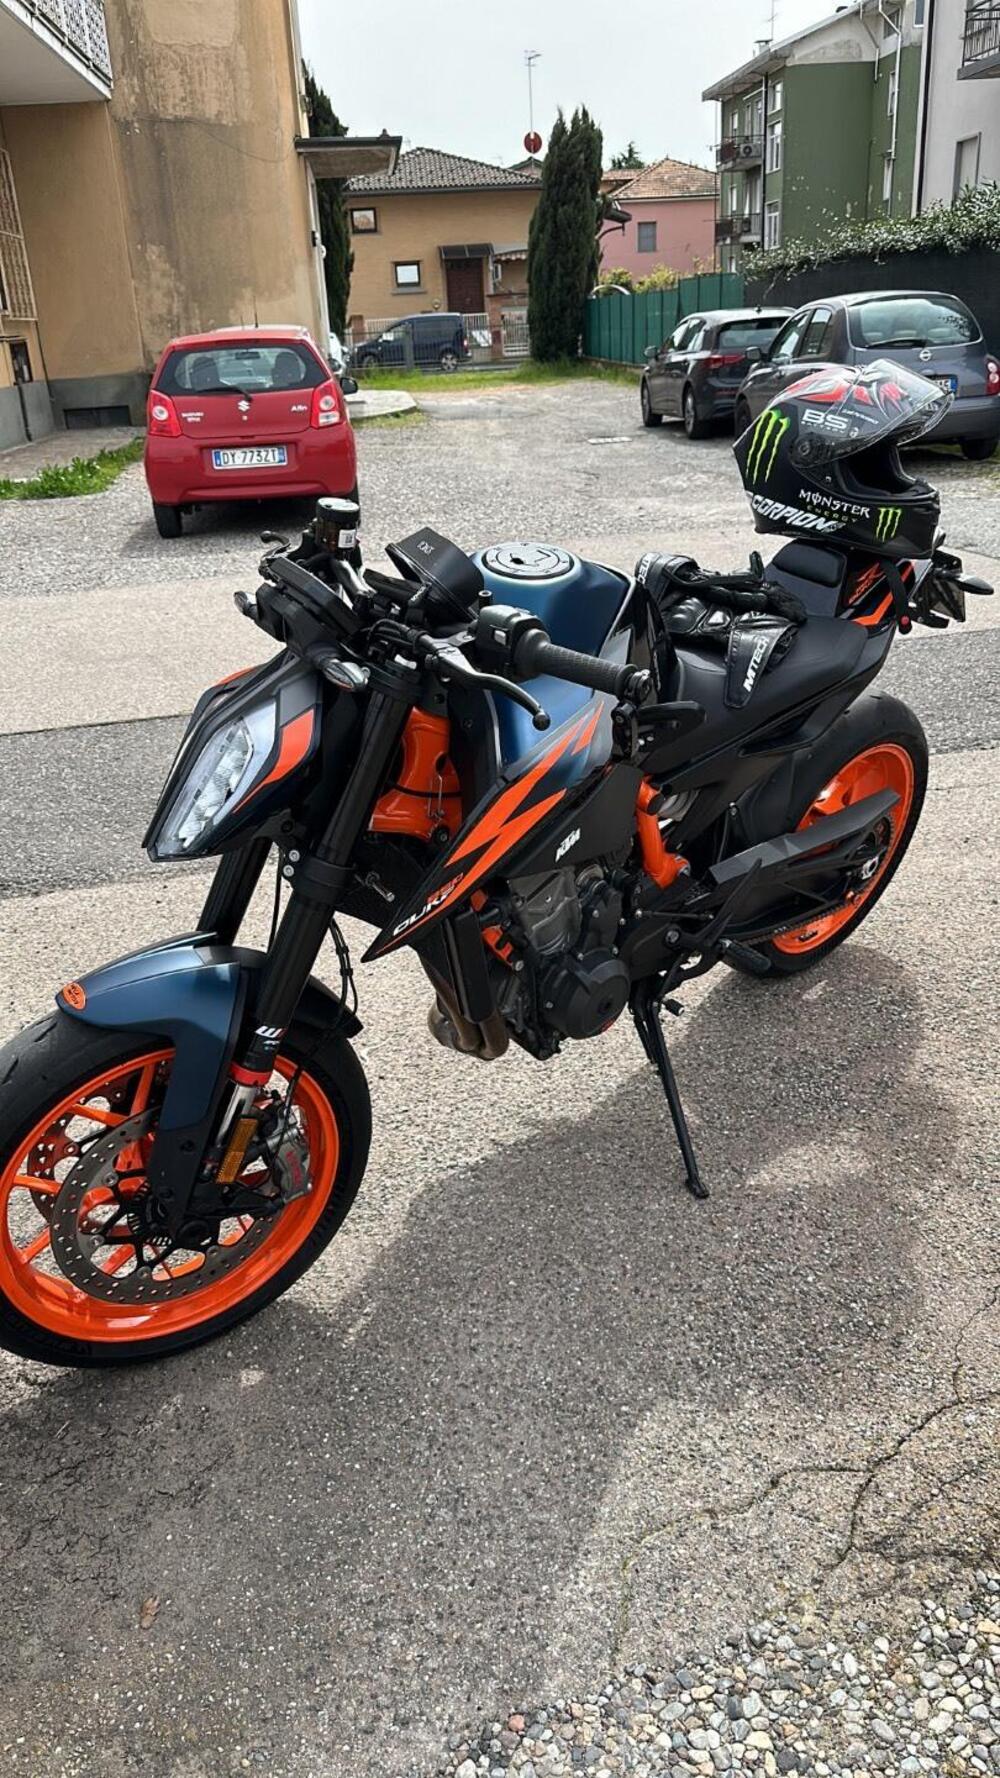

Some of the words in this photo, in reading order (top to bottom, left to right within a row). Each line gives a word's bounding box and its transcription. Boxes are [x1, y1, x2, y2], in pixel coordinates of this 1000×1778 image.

[802, 408, 848, 429] BS
[222, 451, 236, 465] DY
[241, 448, 277, 464] 773ZT
[747, 490, 838, 532] CORPION
[799, 489, 870, 518] MONSTER
[807, 505, 857, 522] ENERGY
[743, 636, 769, 692] MTECH
